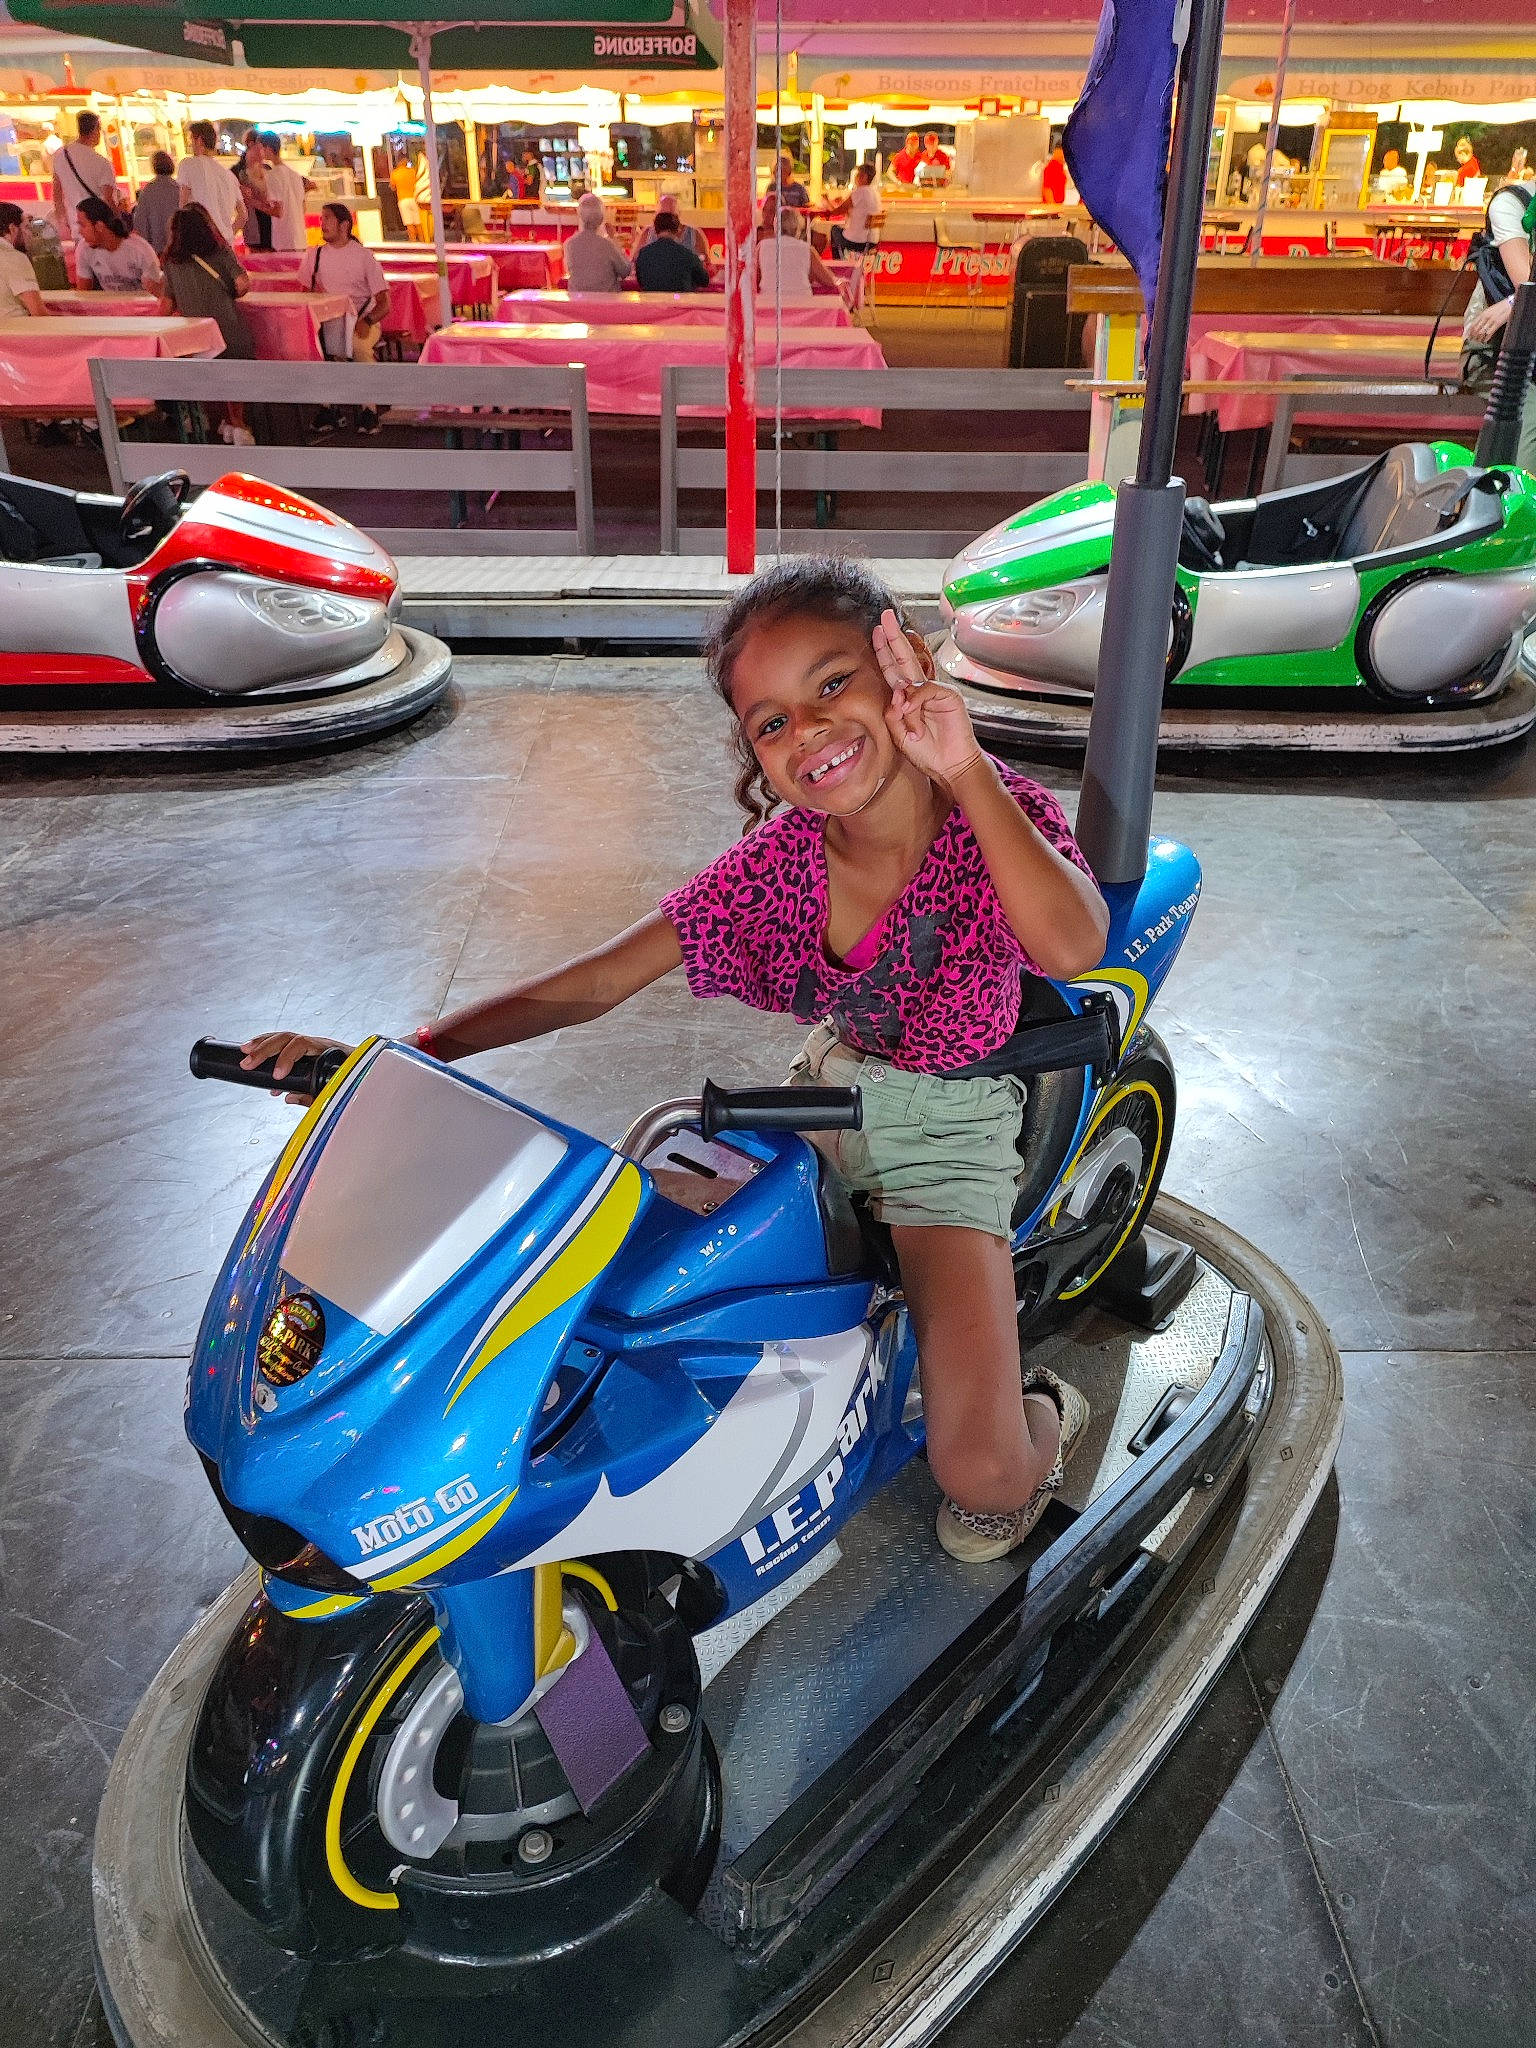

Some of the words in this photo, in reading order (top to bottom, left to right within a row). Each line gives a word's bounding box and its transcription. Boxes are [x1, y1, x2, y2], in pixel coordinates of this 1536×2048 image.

[246, 72, 327, 89] Pression
[878, 75, 971, 93] Boissons
[979, 75, 1070, 93] Fraîches
[1298, 79, 1341, 96] Hot
[1347, 79, 1392, 98] Dog
[1400, 79, 1475, 97] Kebab
[1123, 938, 1150, 963] I.E.
[1144, 915, 1175, 944] Park
[1167, 893, 1199, 920] Team
[351, 1496, 435, 1556] Moto
[434, 1473, 480, 1515] Go
[755, 1543, 800, 1577] Racing
[799, 1514, 832, 1545] team
